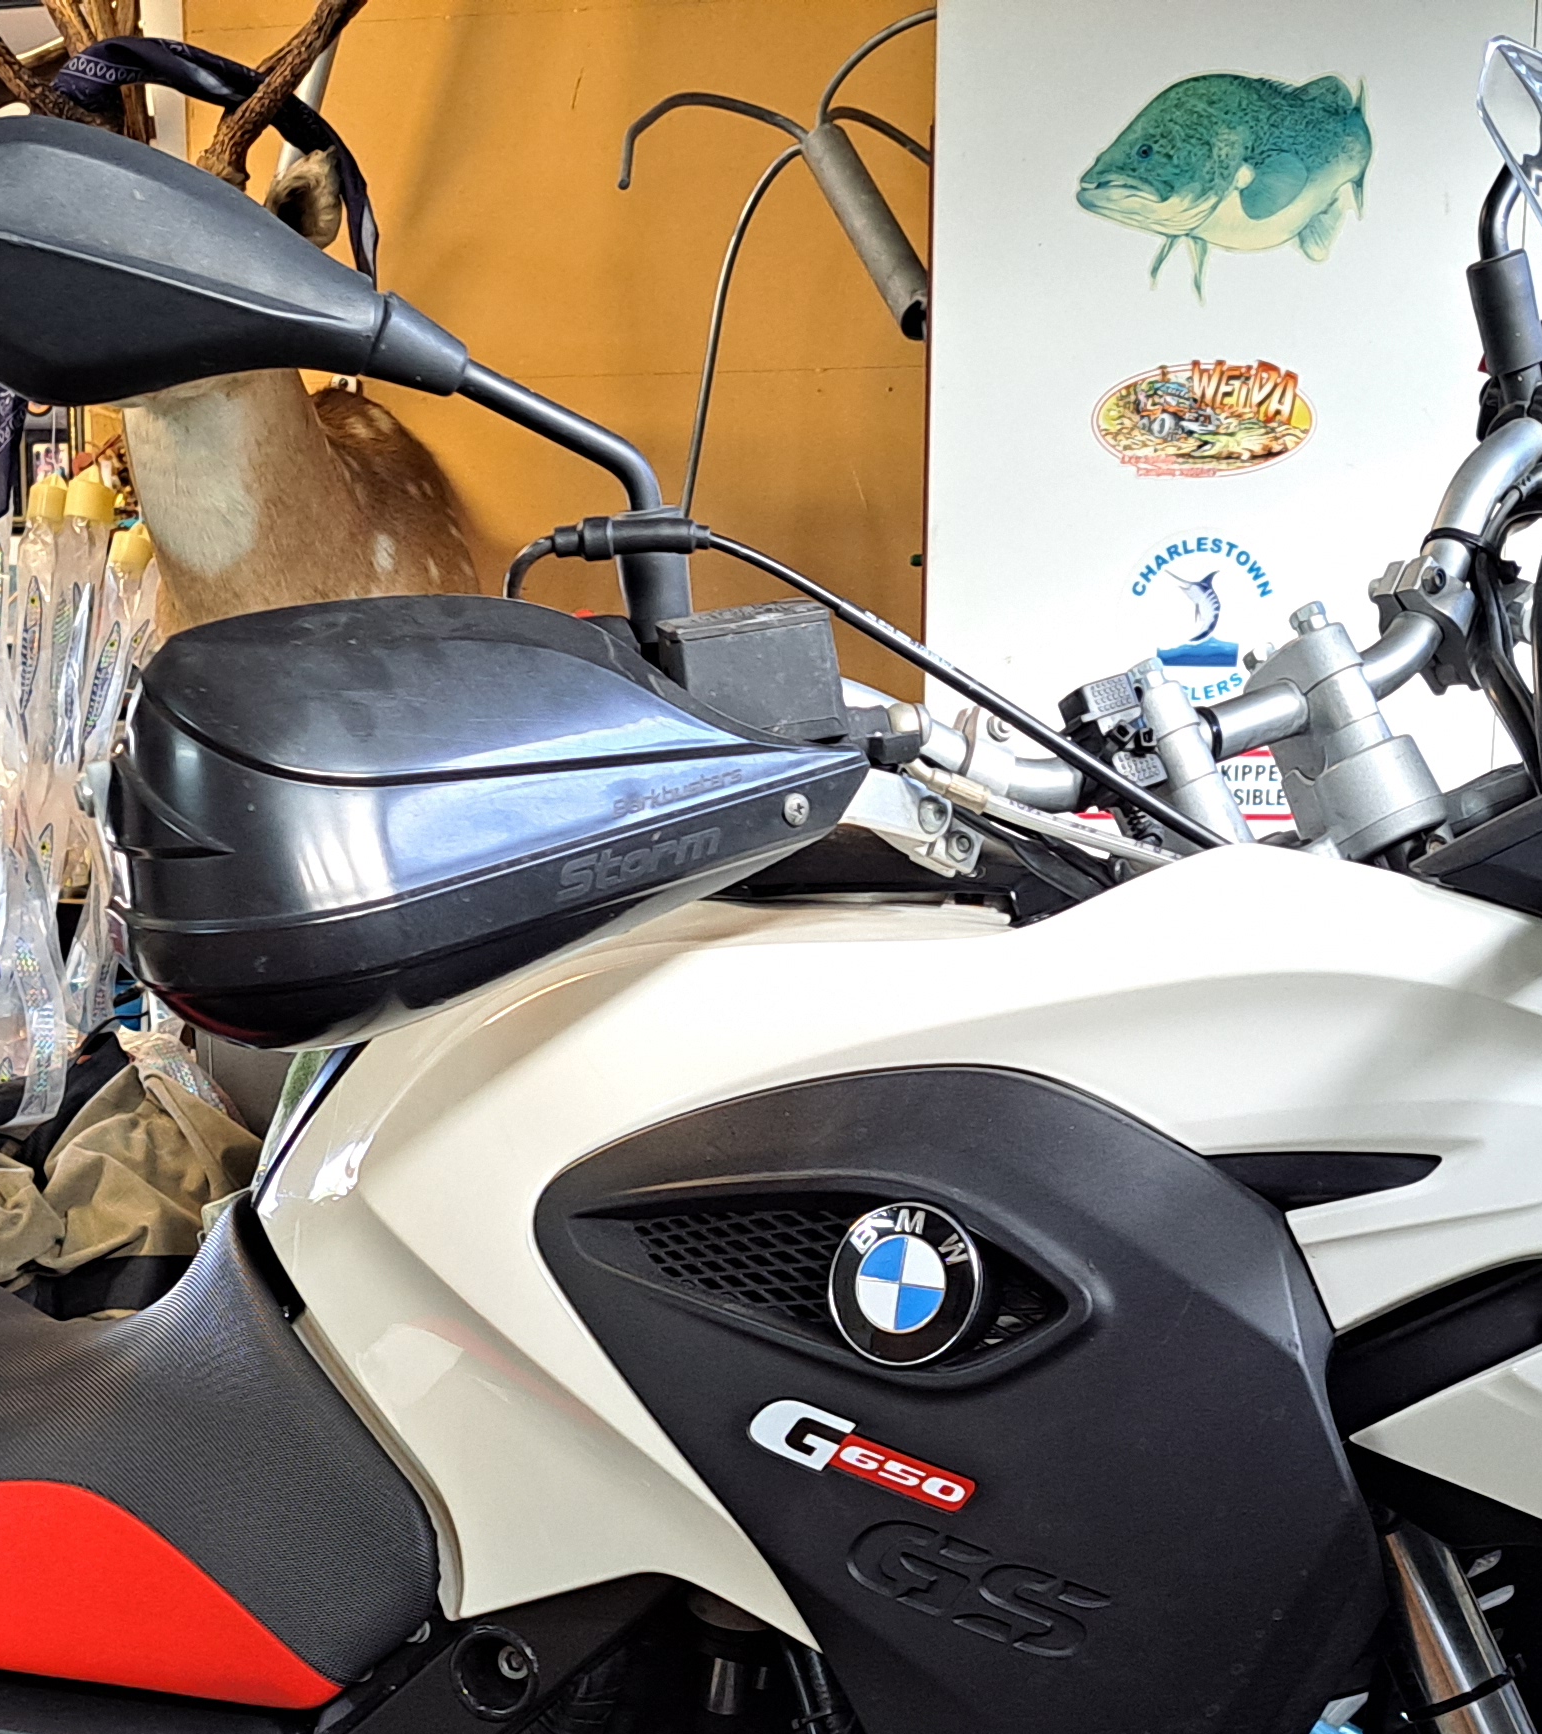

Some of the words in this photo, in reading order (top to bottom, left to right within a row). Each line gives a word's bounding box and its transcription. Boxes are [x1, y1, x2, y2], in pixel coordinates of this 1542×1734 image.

[1132, 537, 1273, 598] CHARLESTOWN
[1181, 672, 1244, 701] LERS
[1220, 763, 1281, 783] KIPPE
[1233, 788, 1286, 807] SIBLE
[557, 826, 722, 899] Storm
[849, 1207, 969, 1267] BMW
[846, 1519, 1112, 1659] GS
